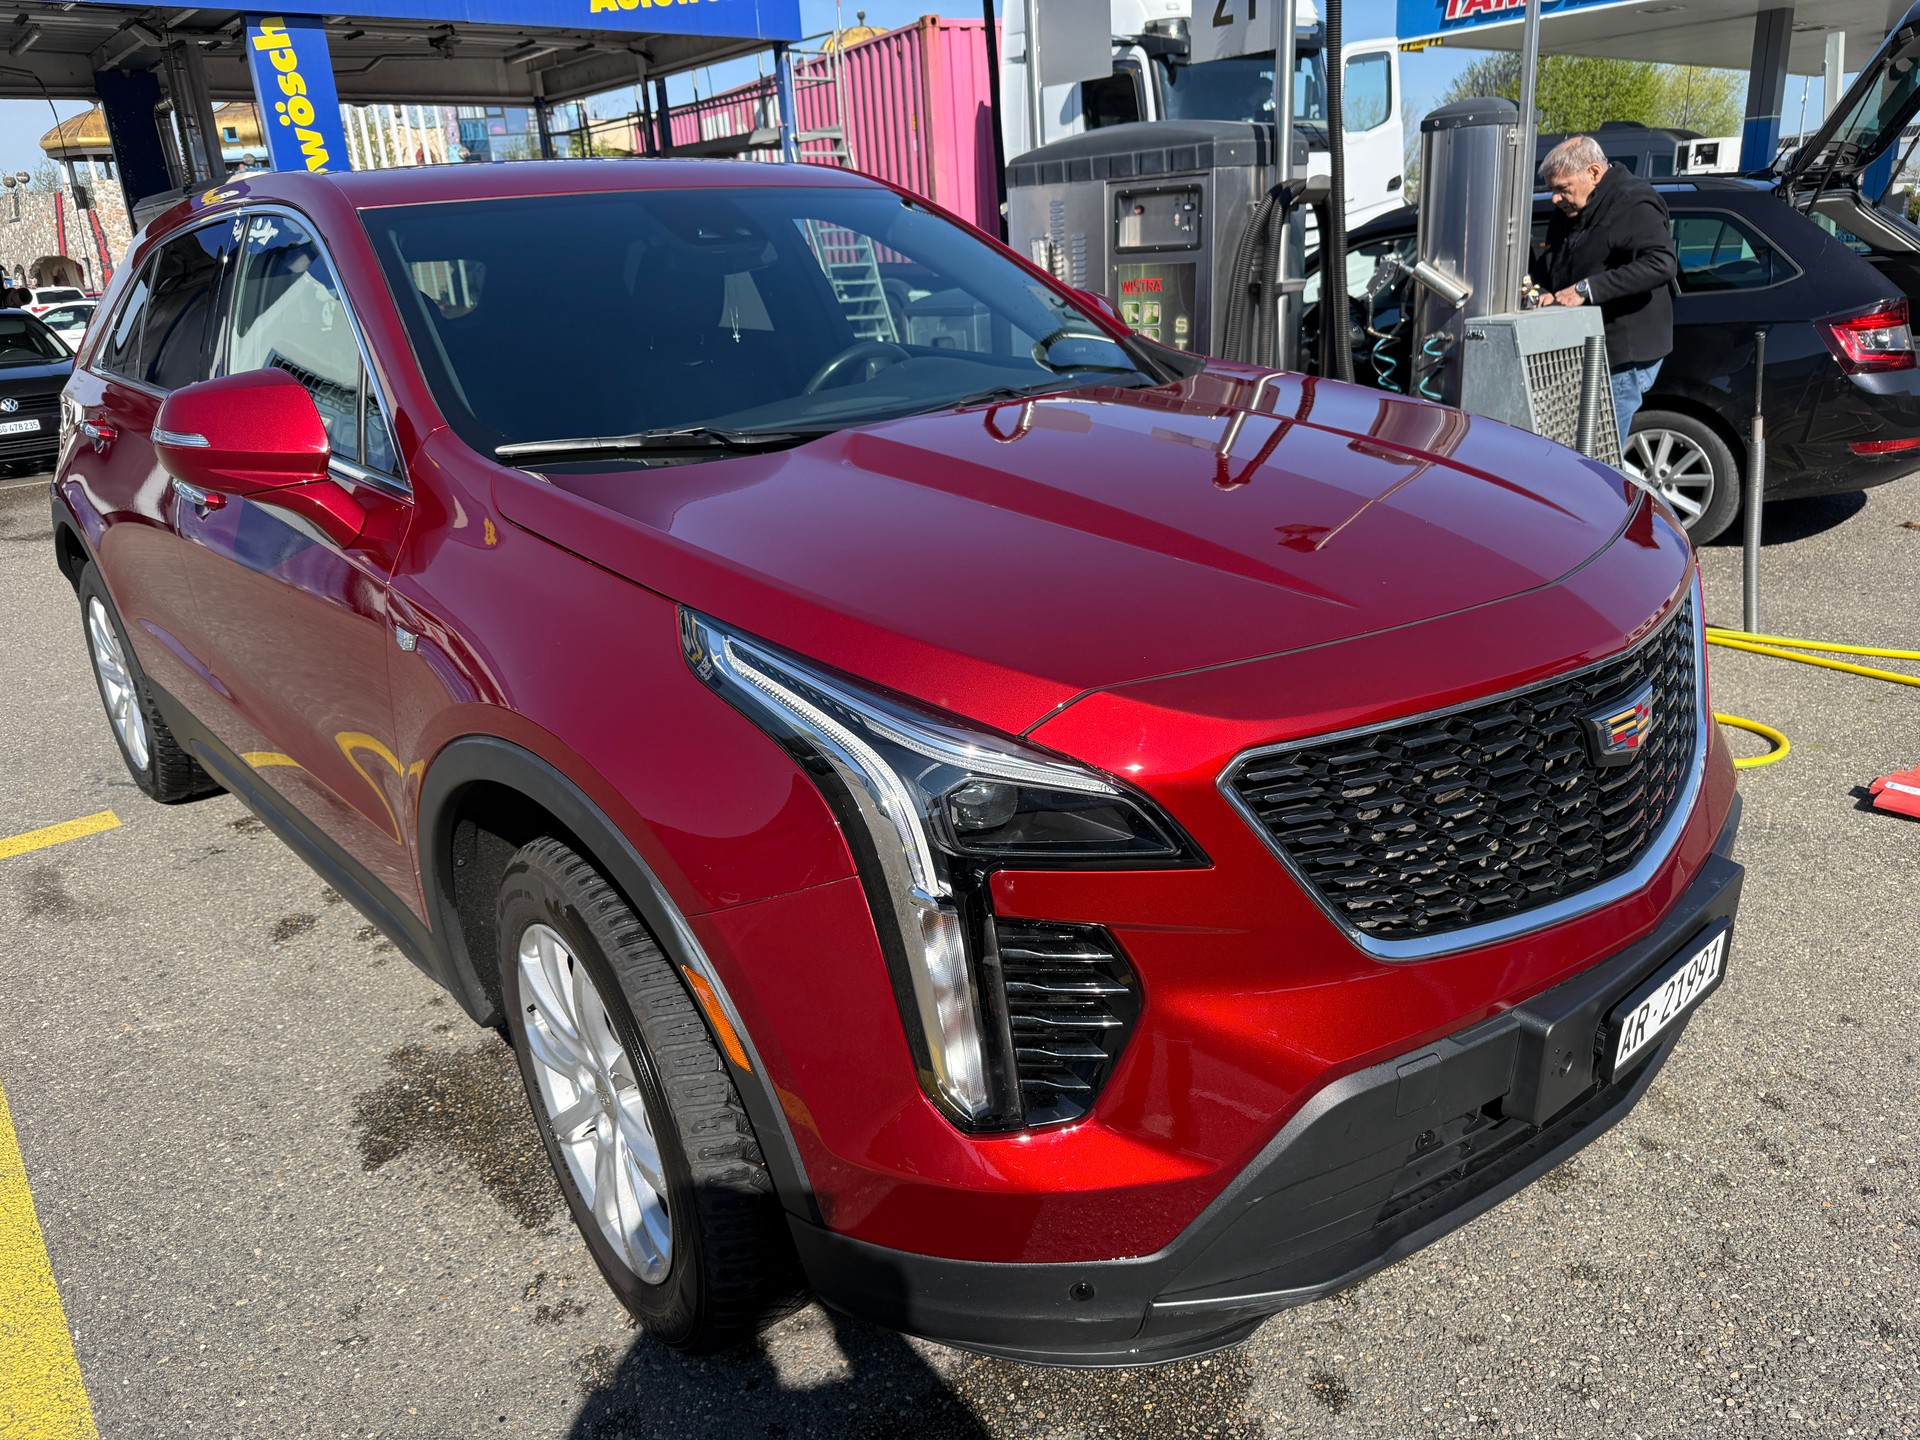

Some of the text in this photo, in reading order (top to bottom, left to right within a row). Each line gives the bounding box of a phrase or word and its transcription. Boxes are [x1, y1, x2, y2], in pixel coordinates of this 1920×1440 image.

[252, 16, 329, 173] wösch
[1121, 278, 1163, 295] WISTRA
[9, 421, 39, 431] 478235
